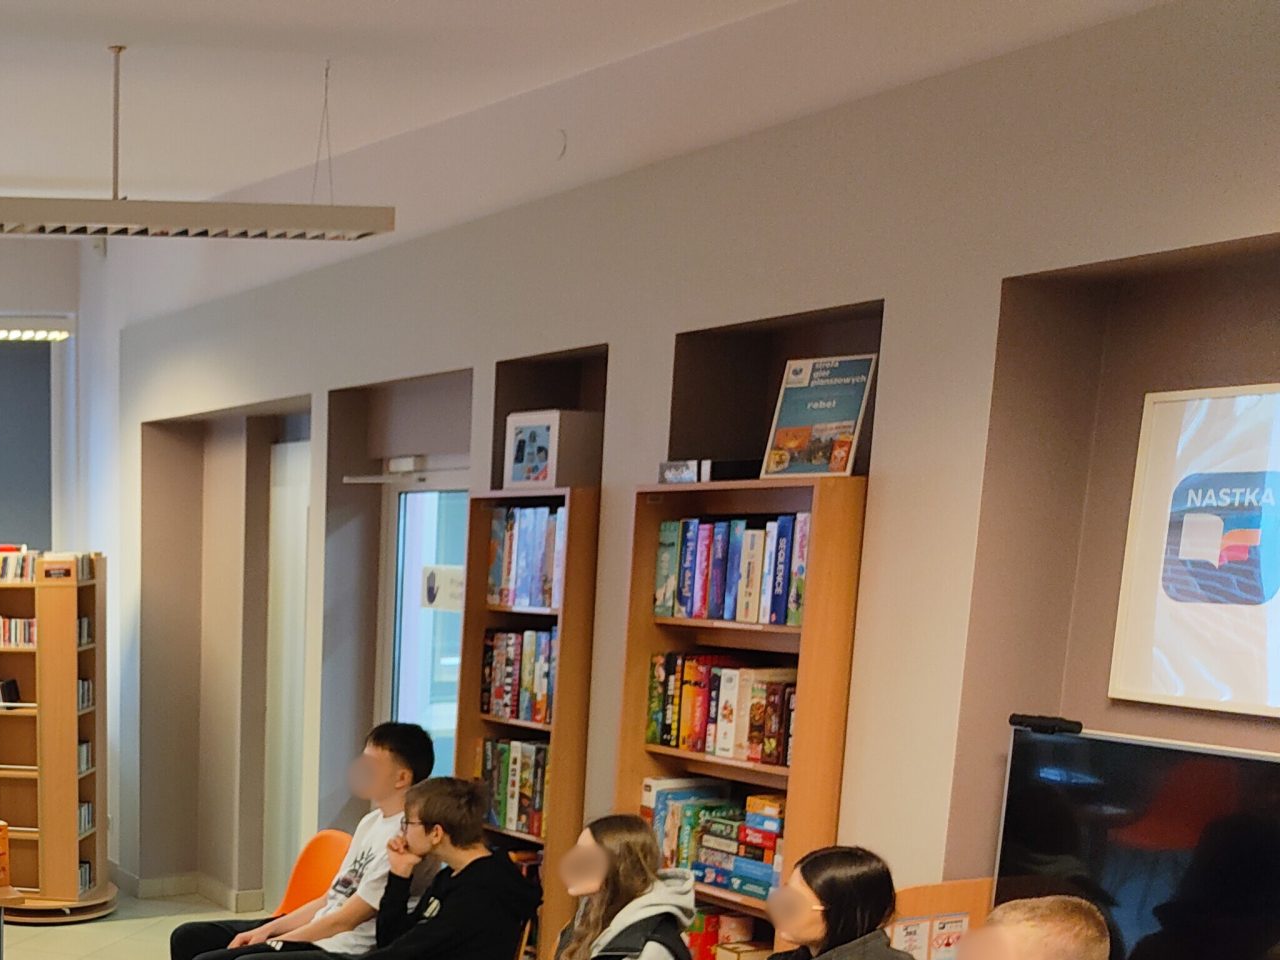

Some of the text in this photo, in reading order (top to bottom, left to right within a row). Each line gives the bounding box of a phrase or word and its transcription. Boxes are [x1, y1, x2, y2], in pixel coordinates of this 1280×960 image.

[807, 399, 837, 410] rebel
[1187, 487, 1277, 508] NASTKA
[774, 537, 788, 596] SEQUENCE
